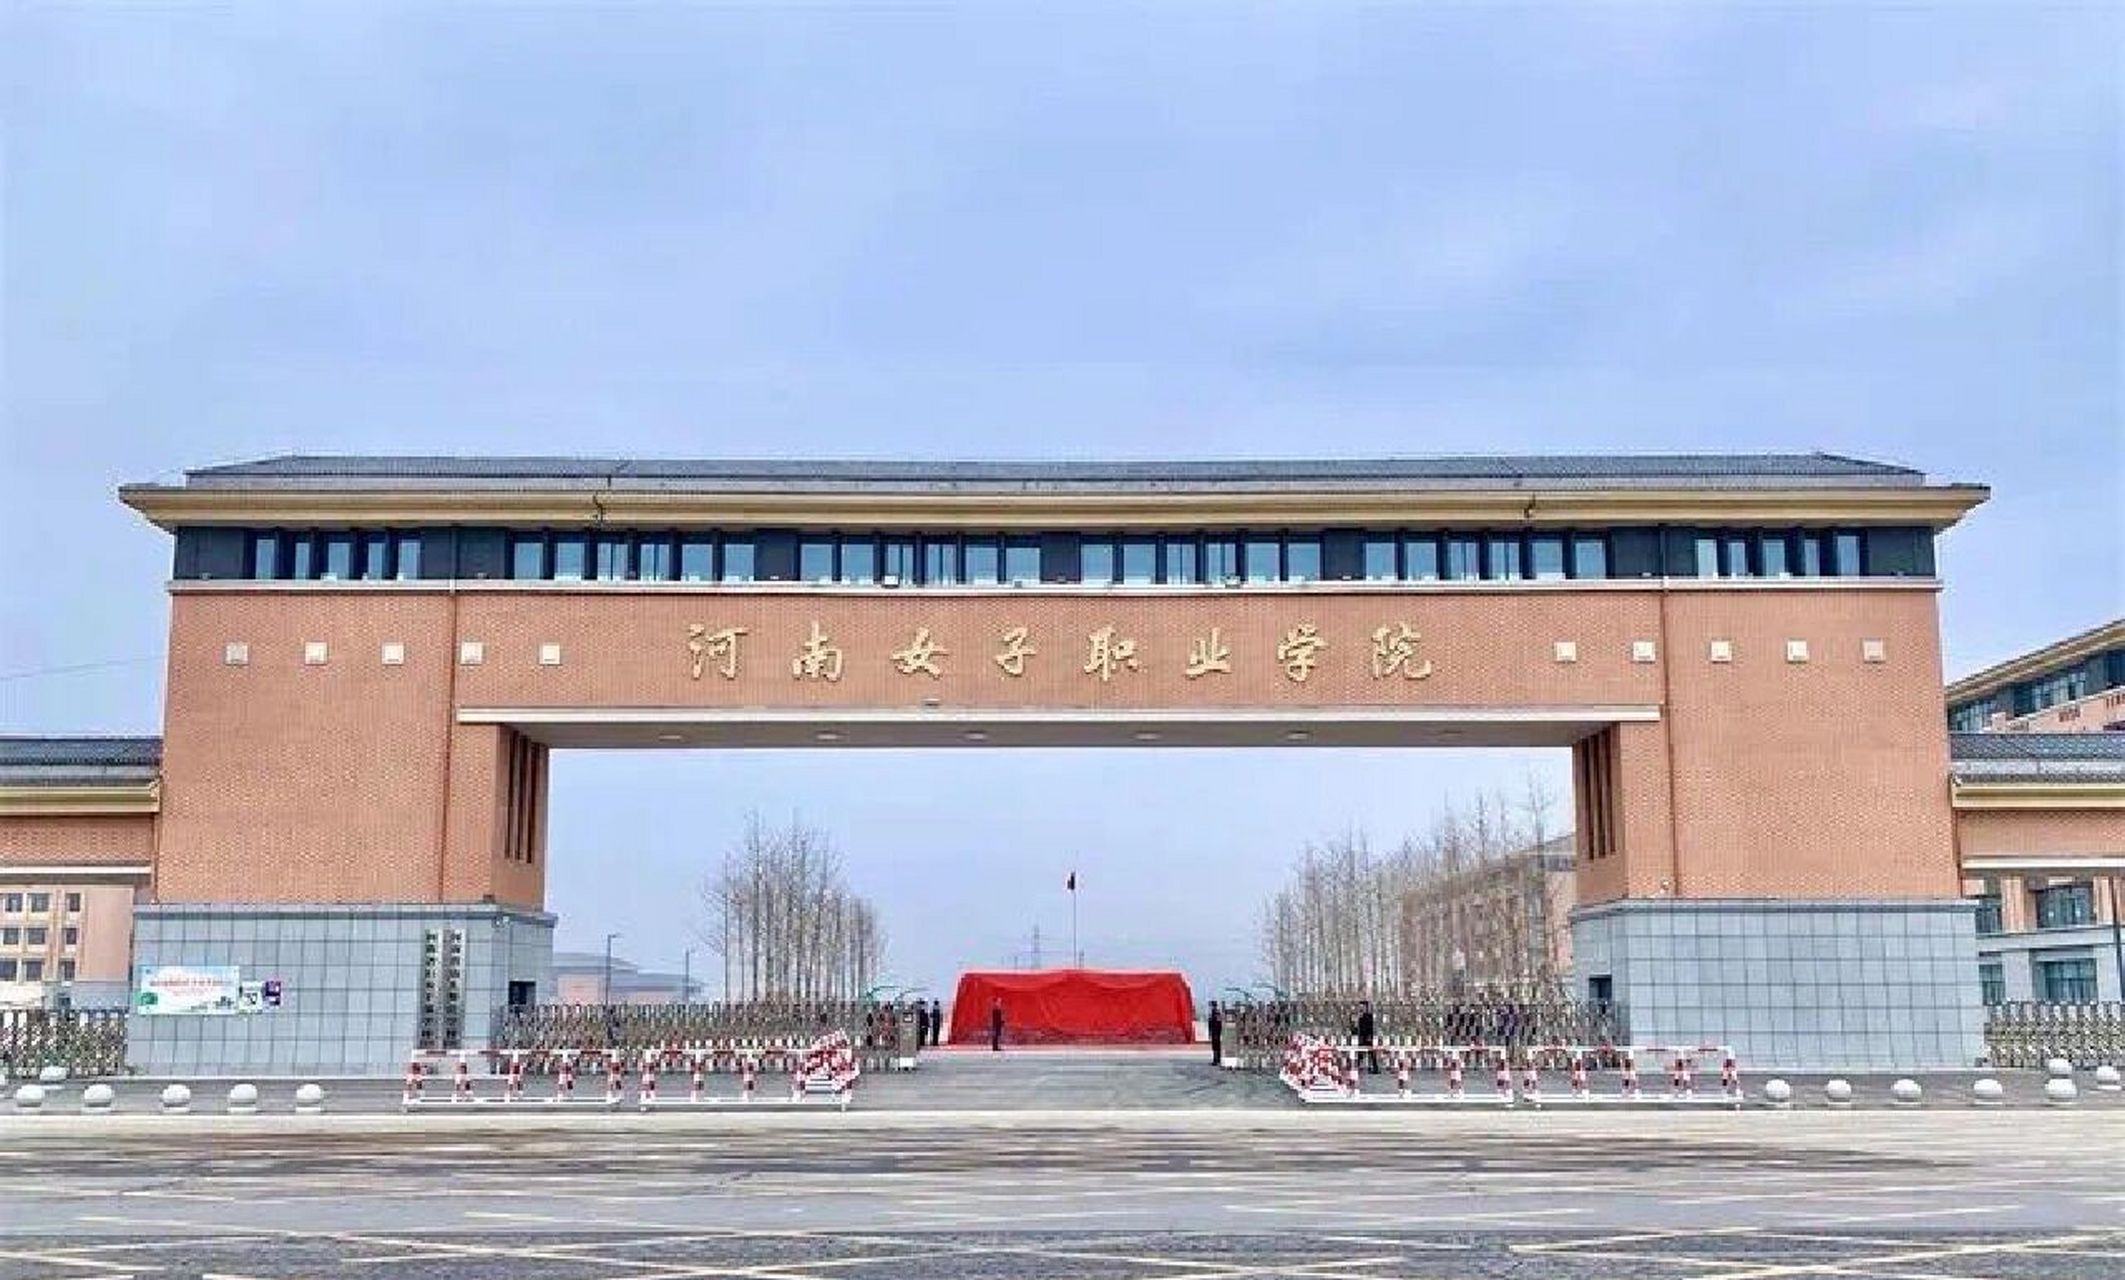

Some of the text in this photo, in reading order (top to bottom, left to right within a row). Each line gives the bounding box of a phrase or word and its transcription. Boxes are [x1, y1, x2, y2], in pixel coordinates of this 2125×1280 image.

[687, 620, 1432, 682] 河南女子职业学院
